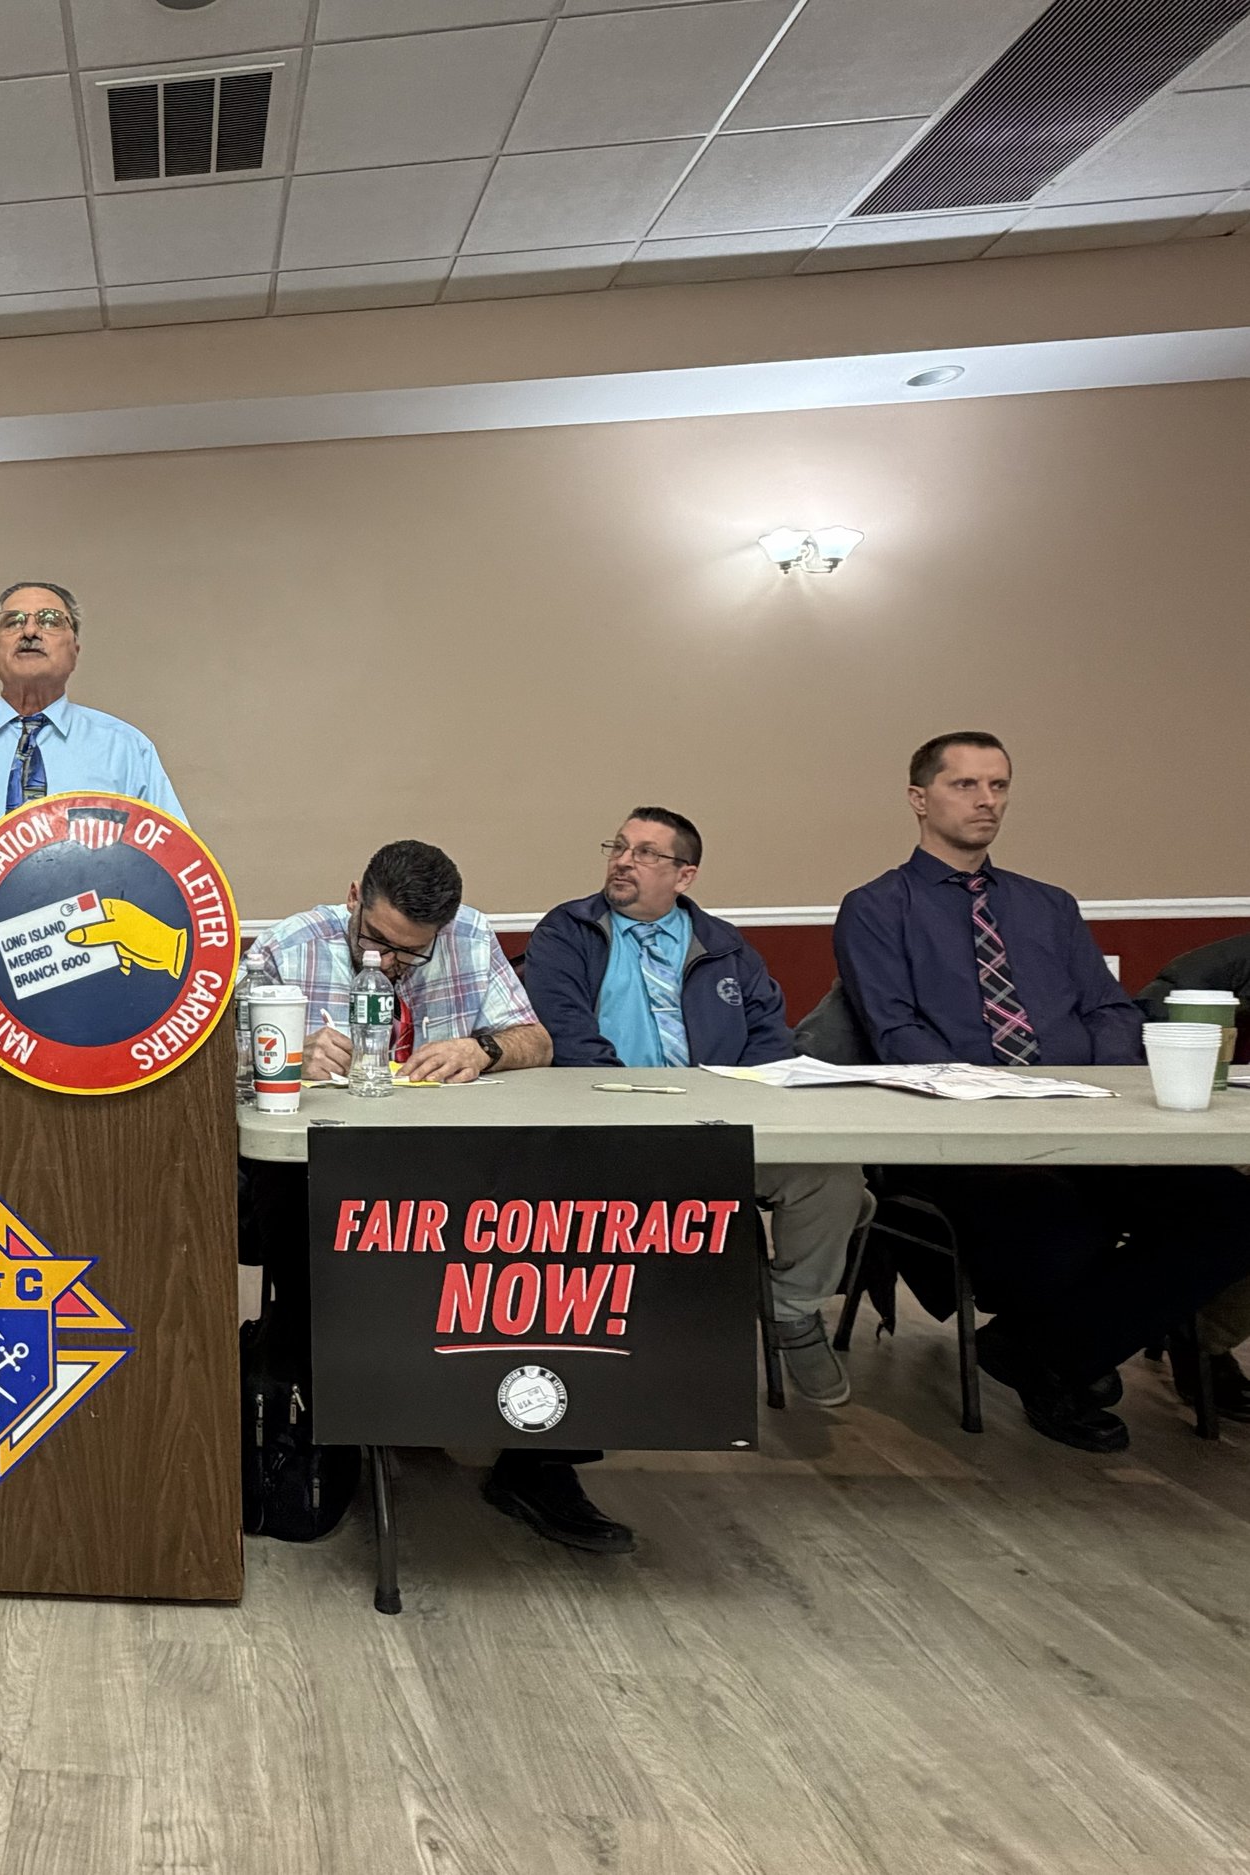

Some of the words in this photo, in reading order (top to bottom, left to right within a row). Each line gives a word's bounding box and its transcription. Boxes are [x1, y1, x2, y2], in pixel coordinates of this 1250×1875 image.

[133, 818, 172, 850] OF
[177, 860, 230, 948] LETTER
[0, 933, 27, 953] LONG
[29, 920, 67, 942] ISLAND
[7, 945, 53, 971] MERGED
[14, 964, 59, 988] BRANCH
[61, 952, 91, 972] 6000
[130, 970, 223, 1070] CARRIERS
[334, 1200, 448, 1252] FAIR
[463, 1199, 739, 1254] CONTRACT
[15, 1268, 43, 1301] C
[435, 1262, 635, 1336] NOW!
